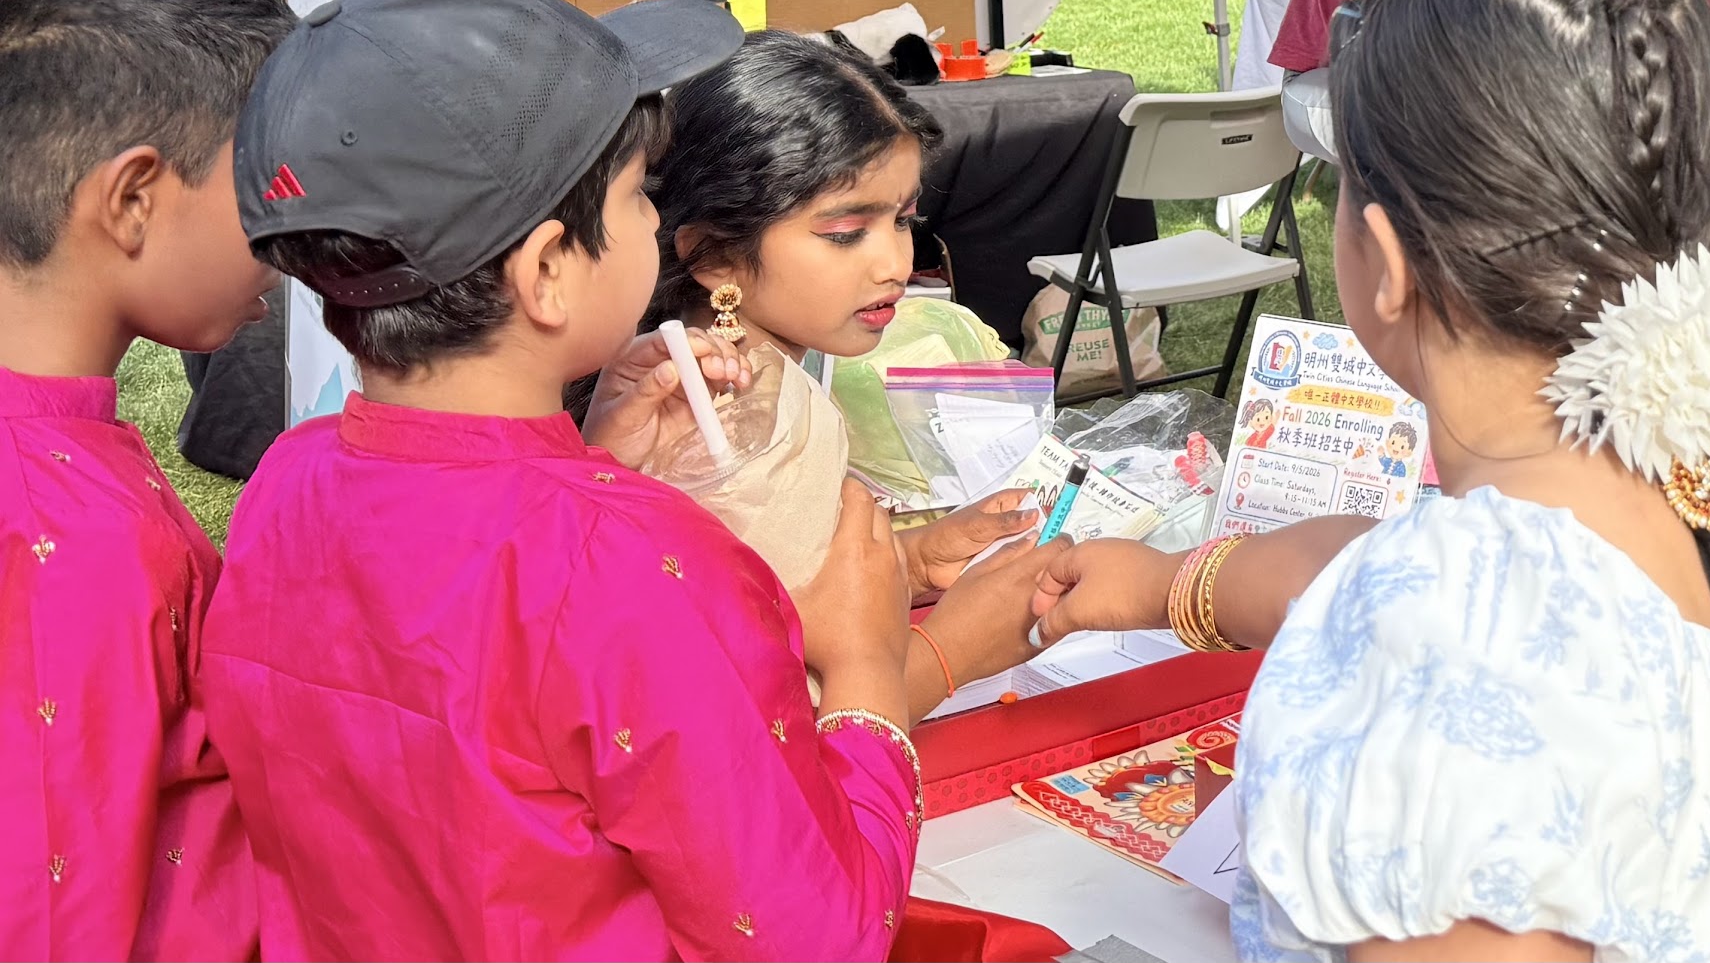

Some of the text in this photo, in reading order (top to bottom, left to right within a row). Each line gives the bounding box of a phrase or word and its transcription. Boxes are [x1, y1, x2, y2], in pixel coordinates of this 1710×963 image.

[1282, 405, 1384, 441] Fall 2026 Enrolling
[1276, 426, 1354, 456] 秋季班招生中
[1254, 473, 1270, 485] Class
[1257, 459, 1275, 471] Start
[1291, 463, 1321, 478] 9/5/2026
